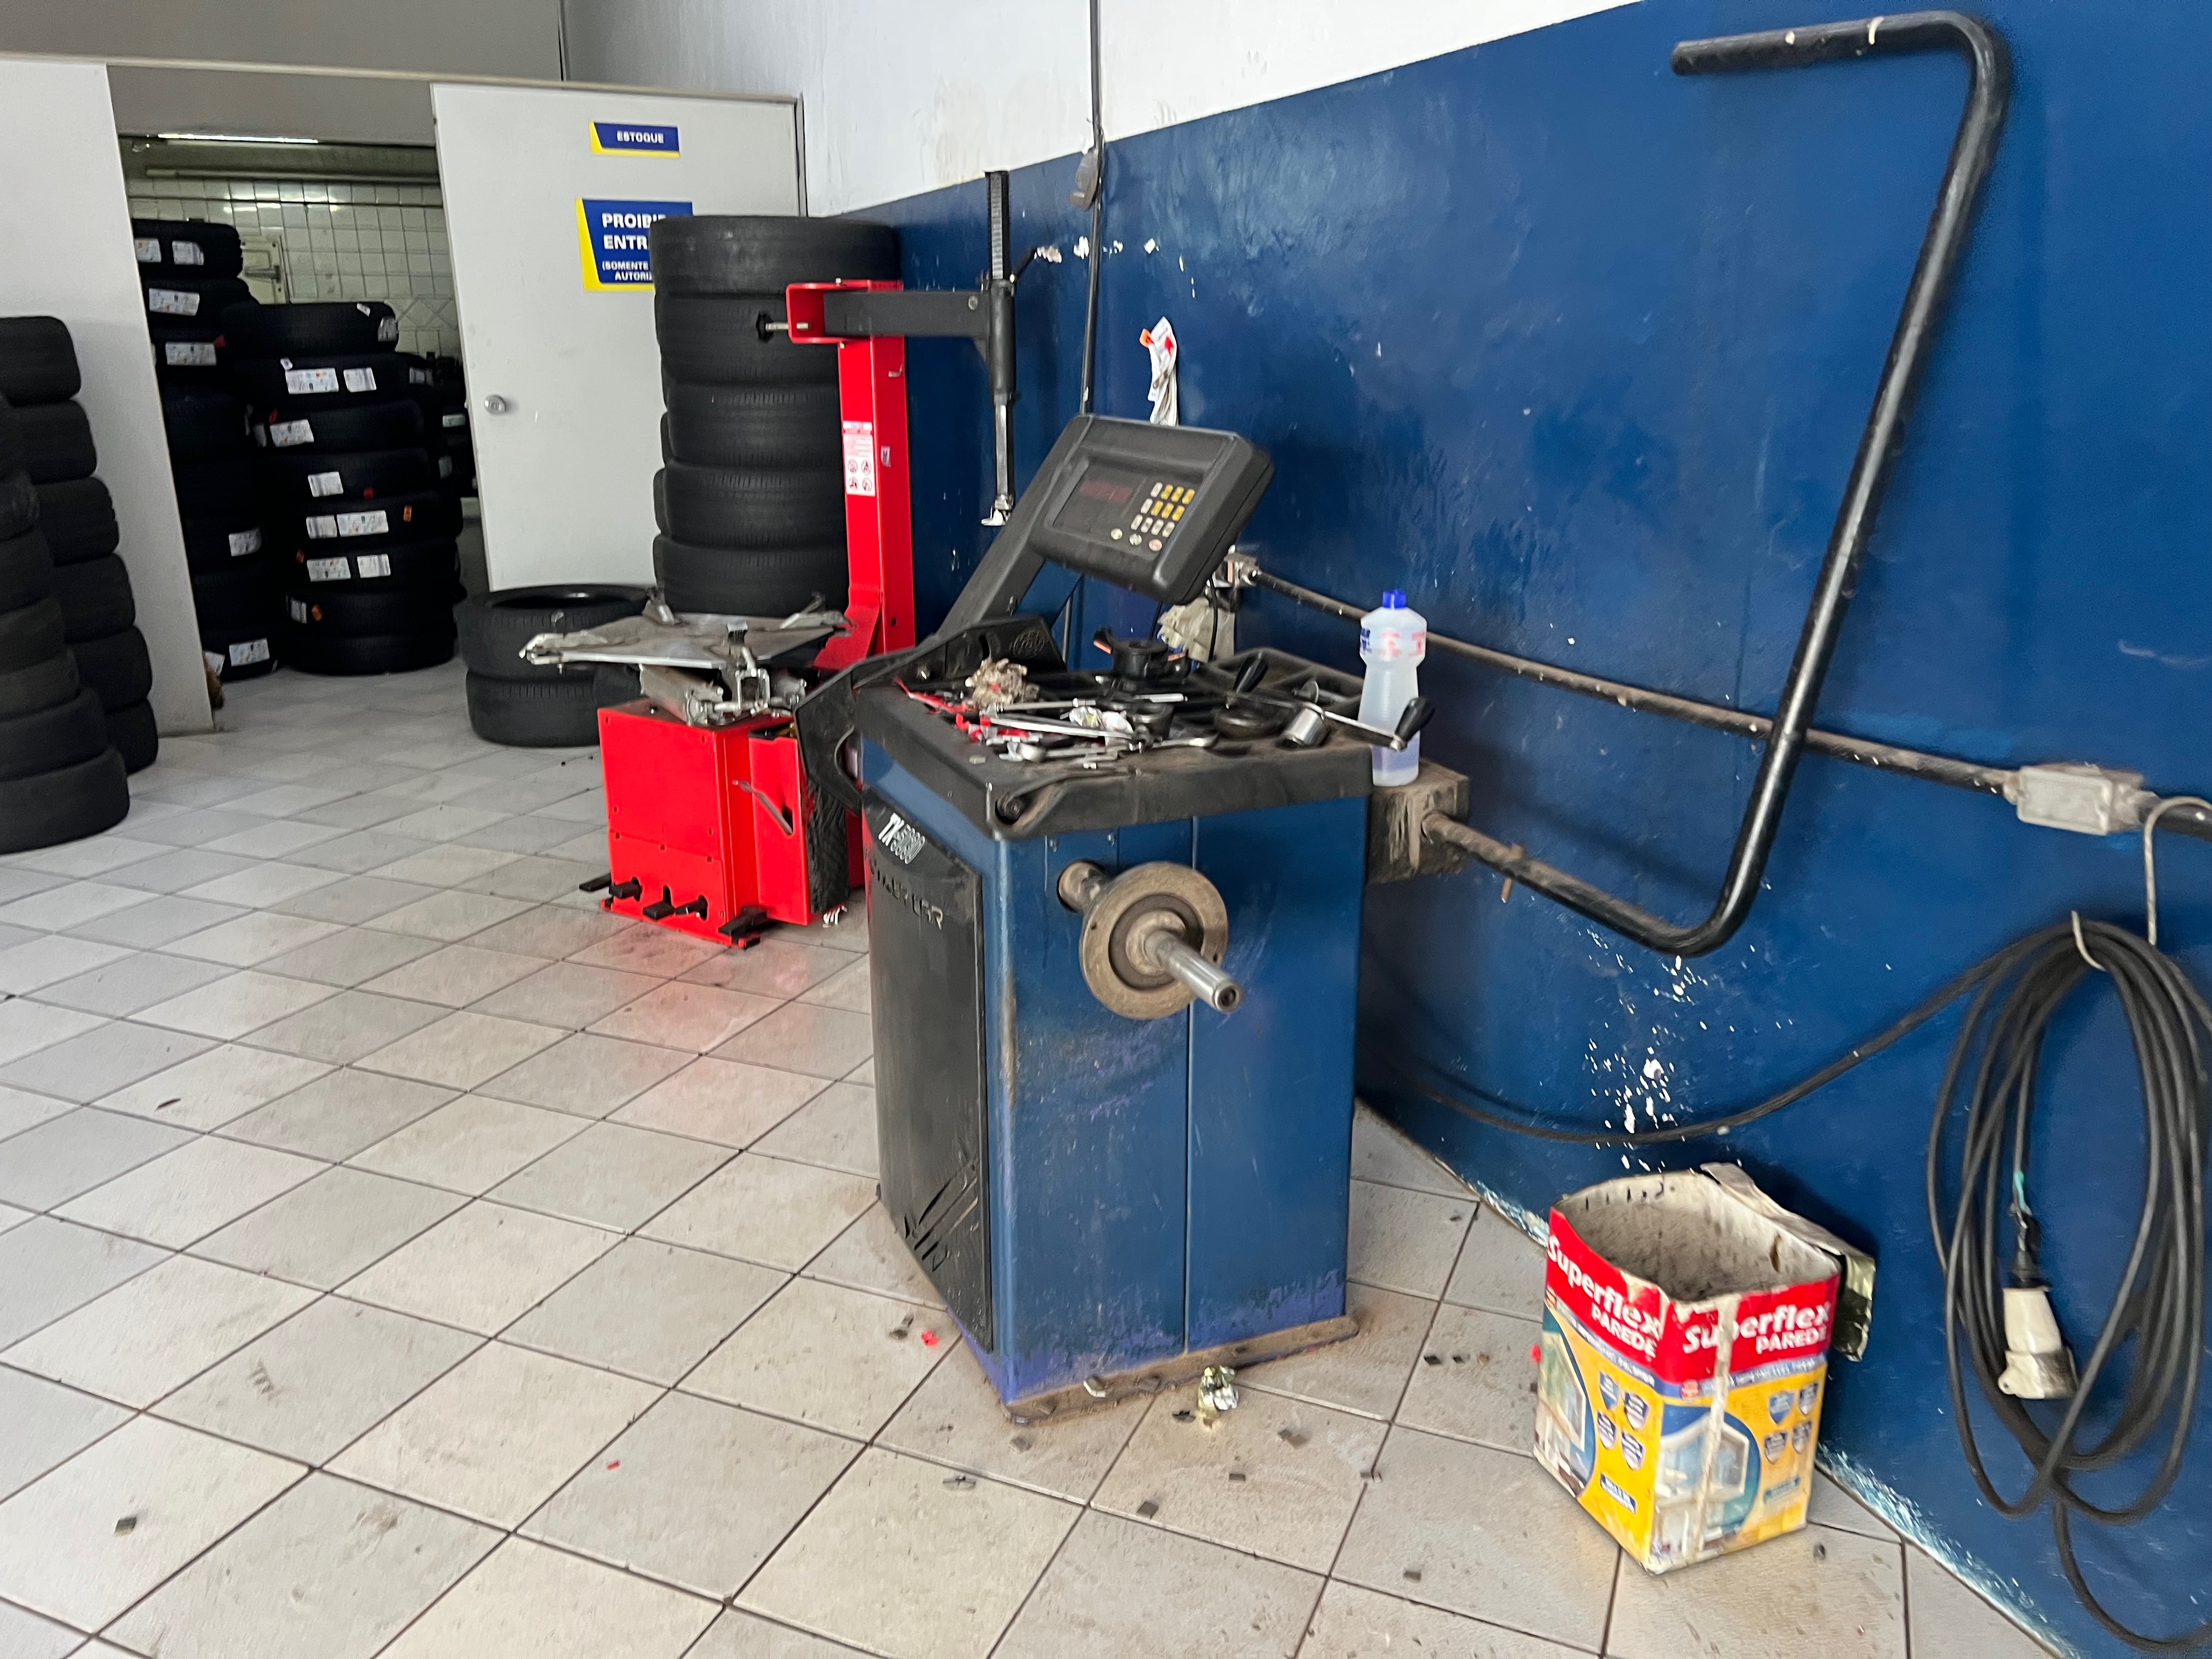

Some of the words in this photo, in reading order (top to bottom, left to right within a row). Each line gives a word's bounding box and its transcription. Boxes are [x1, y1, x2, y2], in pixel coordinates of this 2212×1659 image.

[617, 130, 664, 143] ESTOQUE
[602, 212, 667, 229] PROIBI
[603, 234, 649, 250] ENTR
[602, 261, 649, 271] (SOMENTE
[1547, 1234, 1662, 1342] Superflex
[1592, 1302, 1657, 1358] PAREDE
